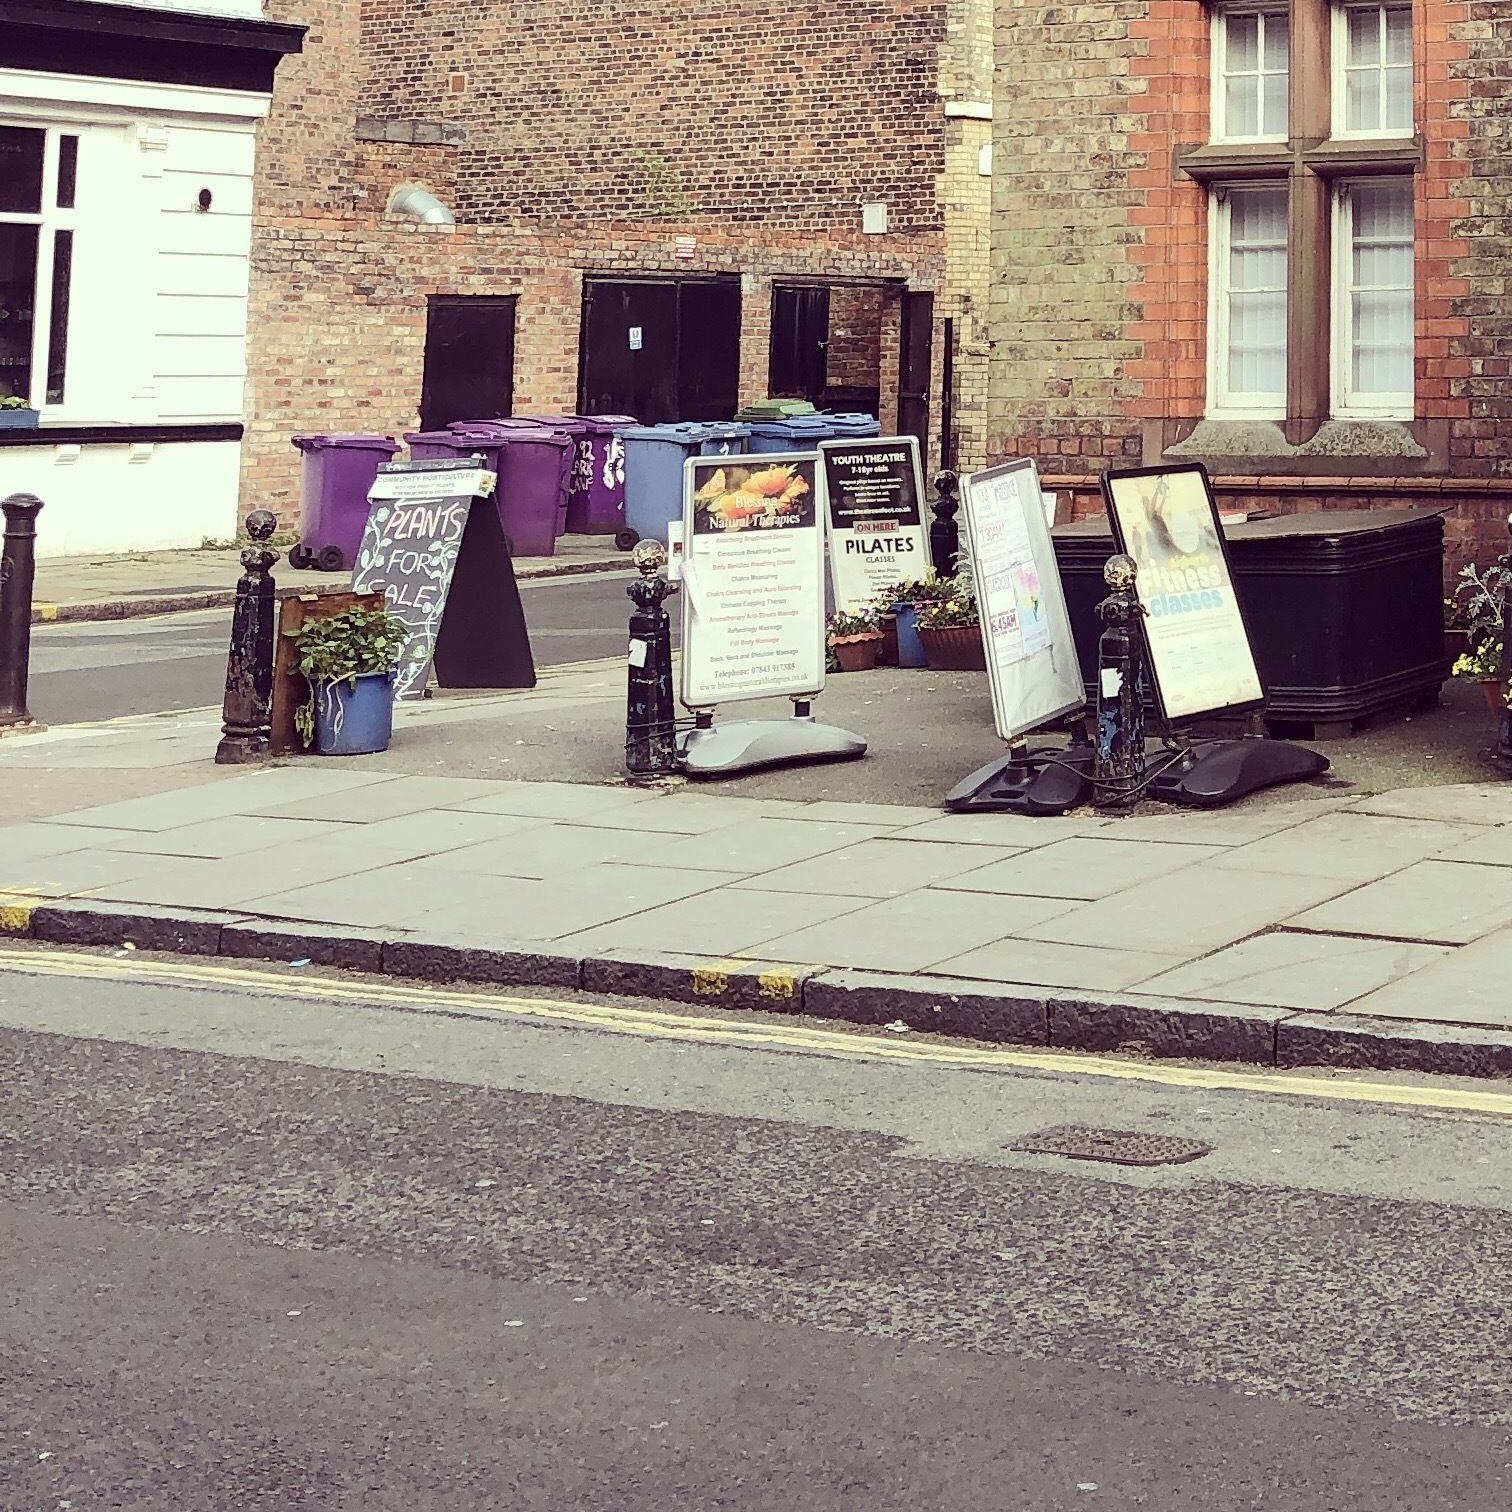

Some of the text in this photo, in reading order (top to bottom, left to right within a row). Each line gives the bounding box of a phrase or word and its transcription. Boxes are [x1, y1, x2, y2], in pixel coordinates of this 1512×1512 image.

[832, 452, 906, 465] YOUTH THEATRE
[422, 472, 475, 482] HORTICULTURE
[735, 495, 778, 509] Blessing
[383, 501, 469, 541] PLANTS
[709, 512, 801, 530] Natural Therapies
[845, 537, 914, 554] PILATES
[386, 549, 432, 578] FOR
[1150, 590, 1223, 617] classes
